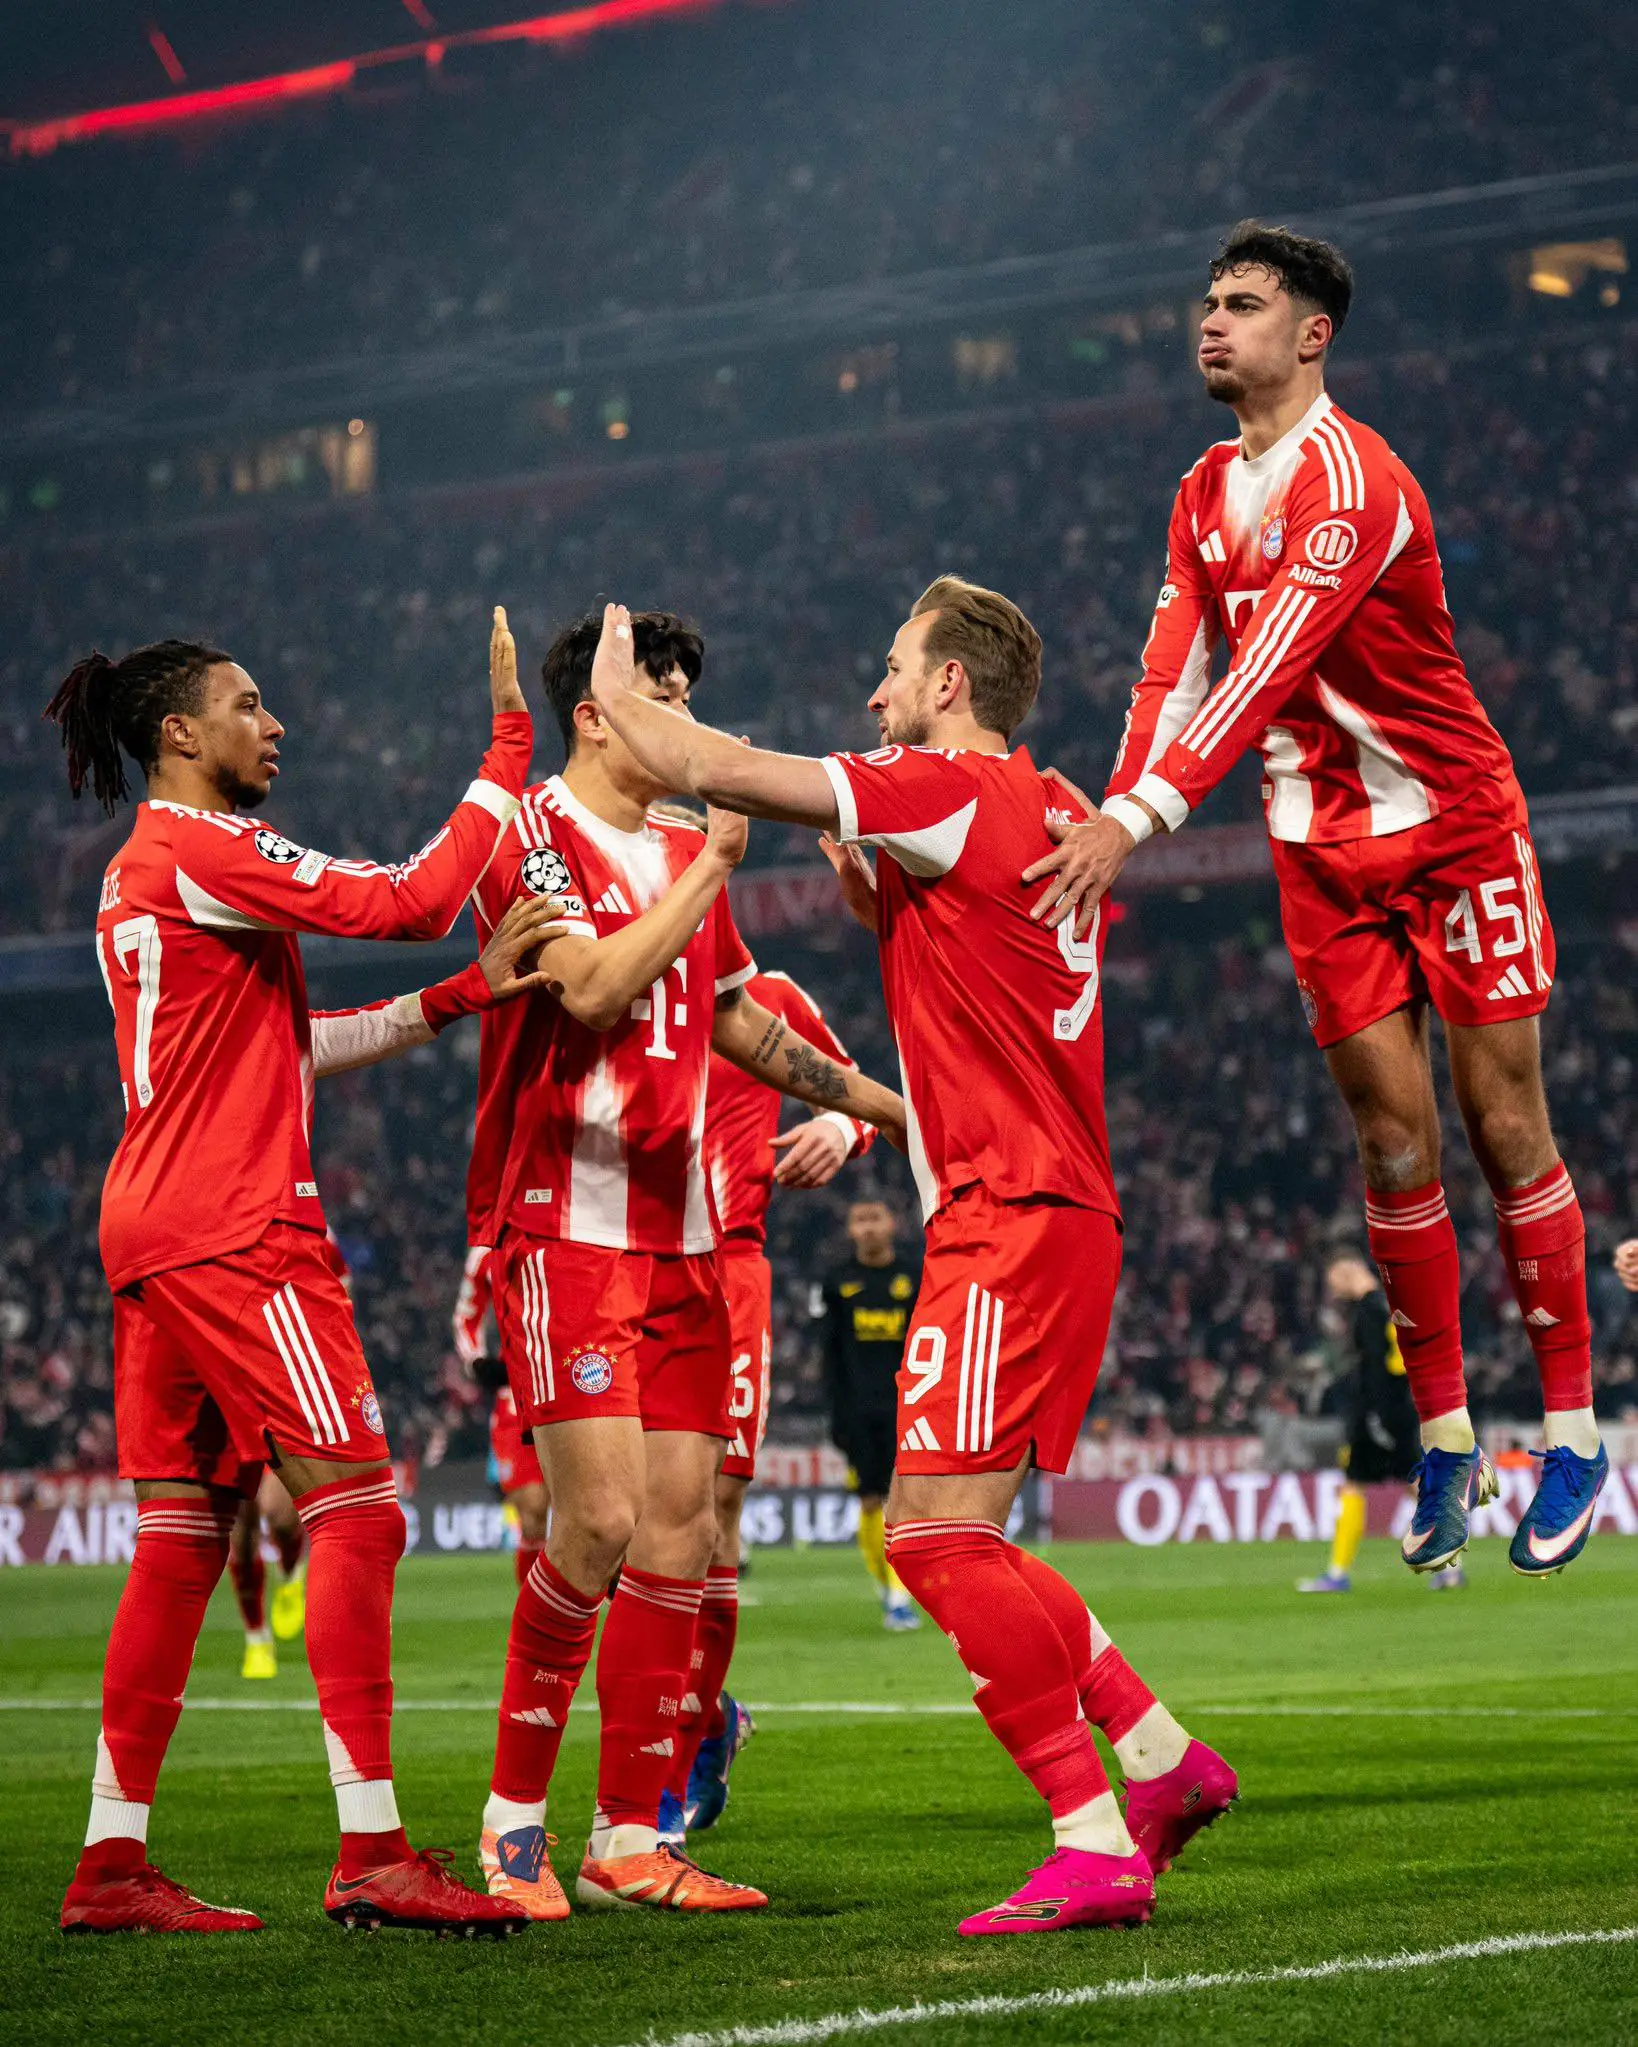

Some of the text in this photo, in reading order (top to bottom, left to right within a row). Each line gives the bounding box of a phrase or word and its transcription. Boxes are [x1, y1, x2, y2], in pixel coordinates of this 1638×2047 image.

[1288, 562, 1343, 590] Allianz
[1444, 876, 1527, 964] 45
[581, 1356, 608, 1371] BAYERN
[903, 1325, 948, 1405] 9
